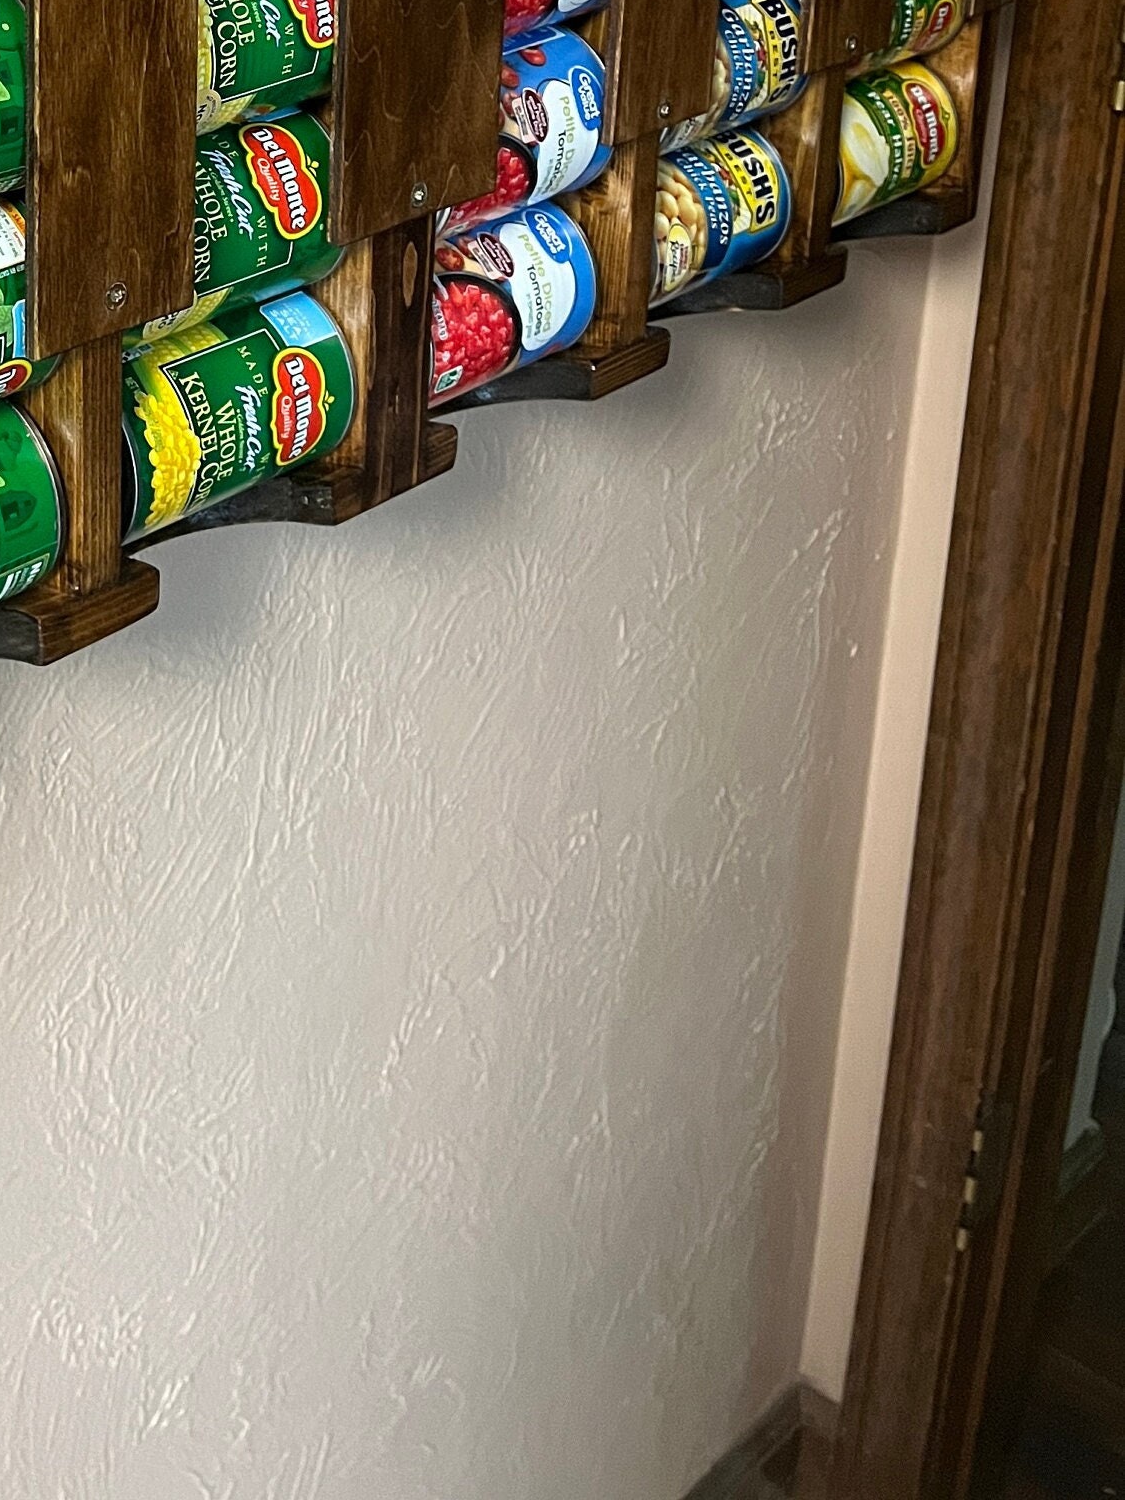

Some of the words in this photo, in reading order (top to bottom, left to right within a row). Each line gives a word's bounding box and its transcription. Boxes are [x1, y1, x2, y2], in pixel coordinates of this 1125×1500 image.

[217, 20, 237, 89] CORN
[282, 22, 294, 75] WITH
[251, 128, 287, 159] Del
[274, 157, 307, 230] Monte
[257, 157, 280, 201] Quality
[231, 193, 254, 240] Cut
[256, 215, 268, 267] WITH
[527, 265, 542, 336] Tomatoes
[236, 345, 268, 398] MADE
[285, 356, 310, 396] Del
[178, 371, 218, 461] KERNEL
[235, 385, 262, 439] Fresh
[276, 395, 293, 439] Quality
[289, 393, 313, 459] Monte
[215, 400, 234, 481] WHOLE
